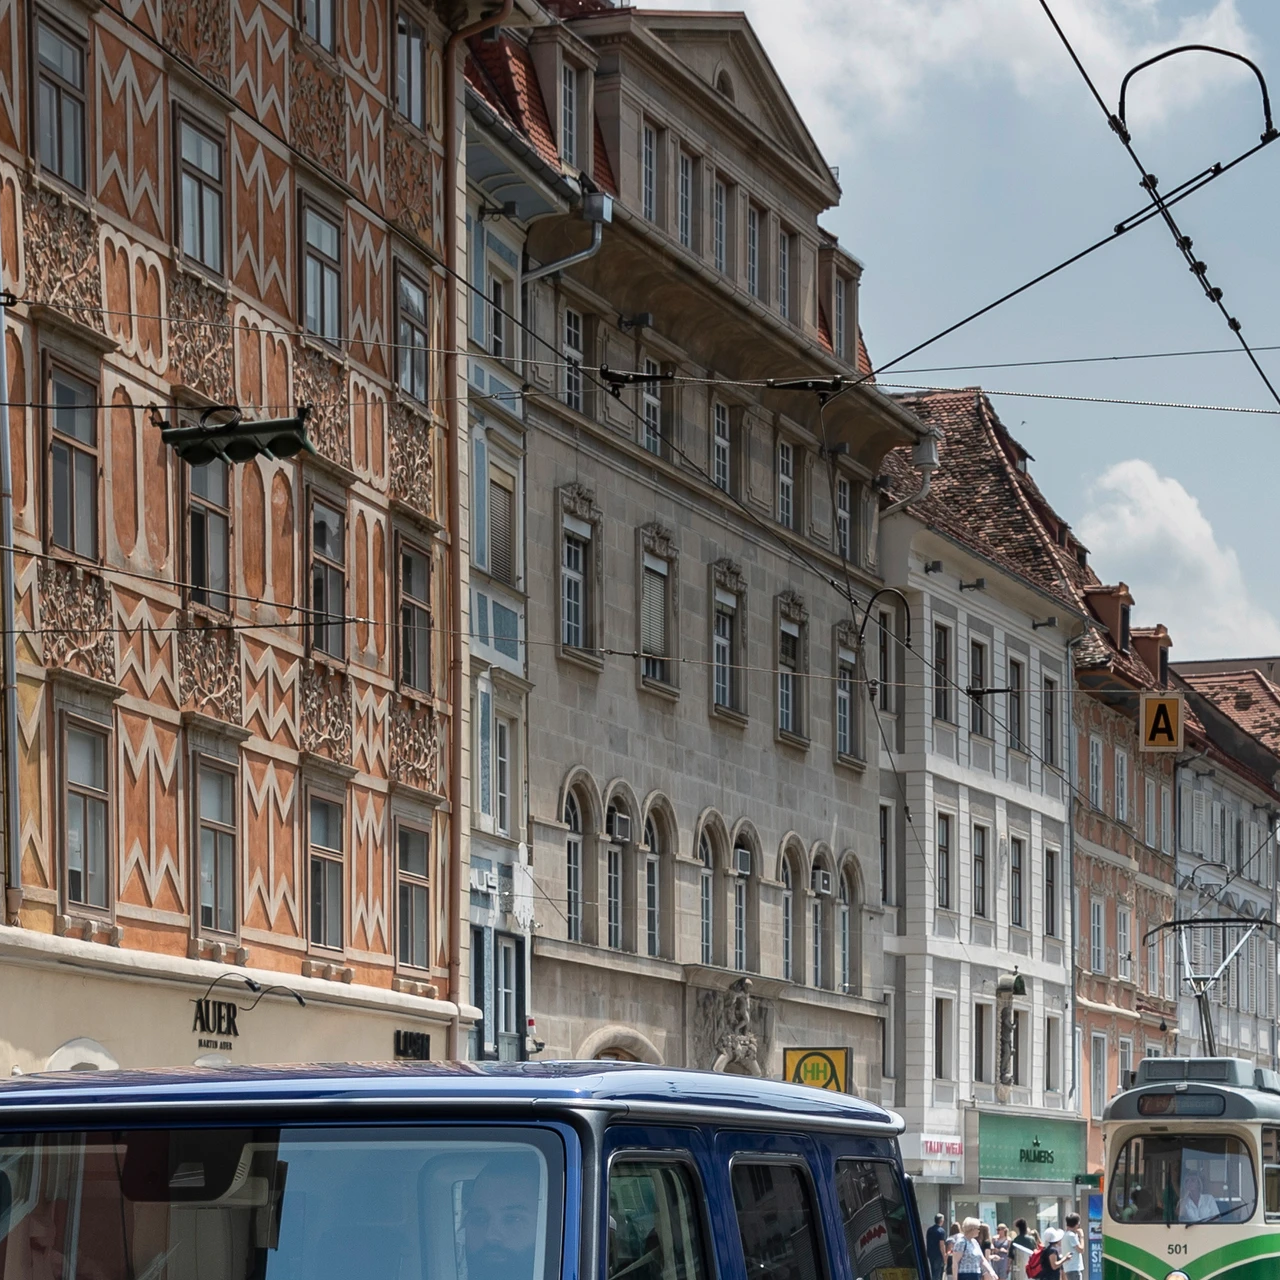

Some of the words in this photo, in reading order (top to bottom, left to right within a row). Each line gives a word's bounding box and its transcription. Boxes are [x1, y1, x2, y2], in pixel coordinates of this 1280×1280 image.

[1149, 704, 1174, 741] A
[192, 998, 239, 1037] AUER
[198, 1039, 218, 1049] MARTIN
[220, 1041, 232, 1050] AUER
[803, 1063, 827, 1080] HH
[1020, 1149, 1054, 1164] PALMERS
[1167, 1244, 1188, 1255] 501
